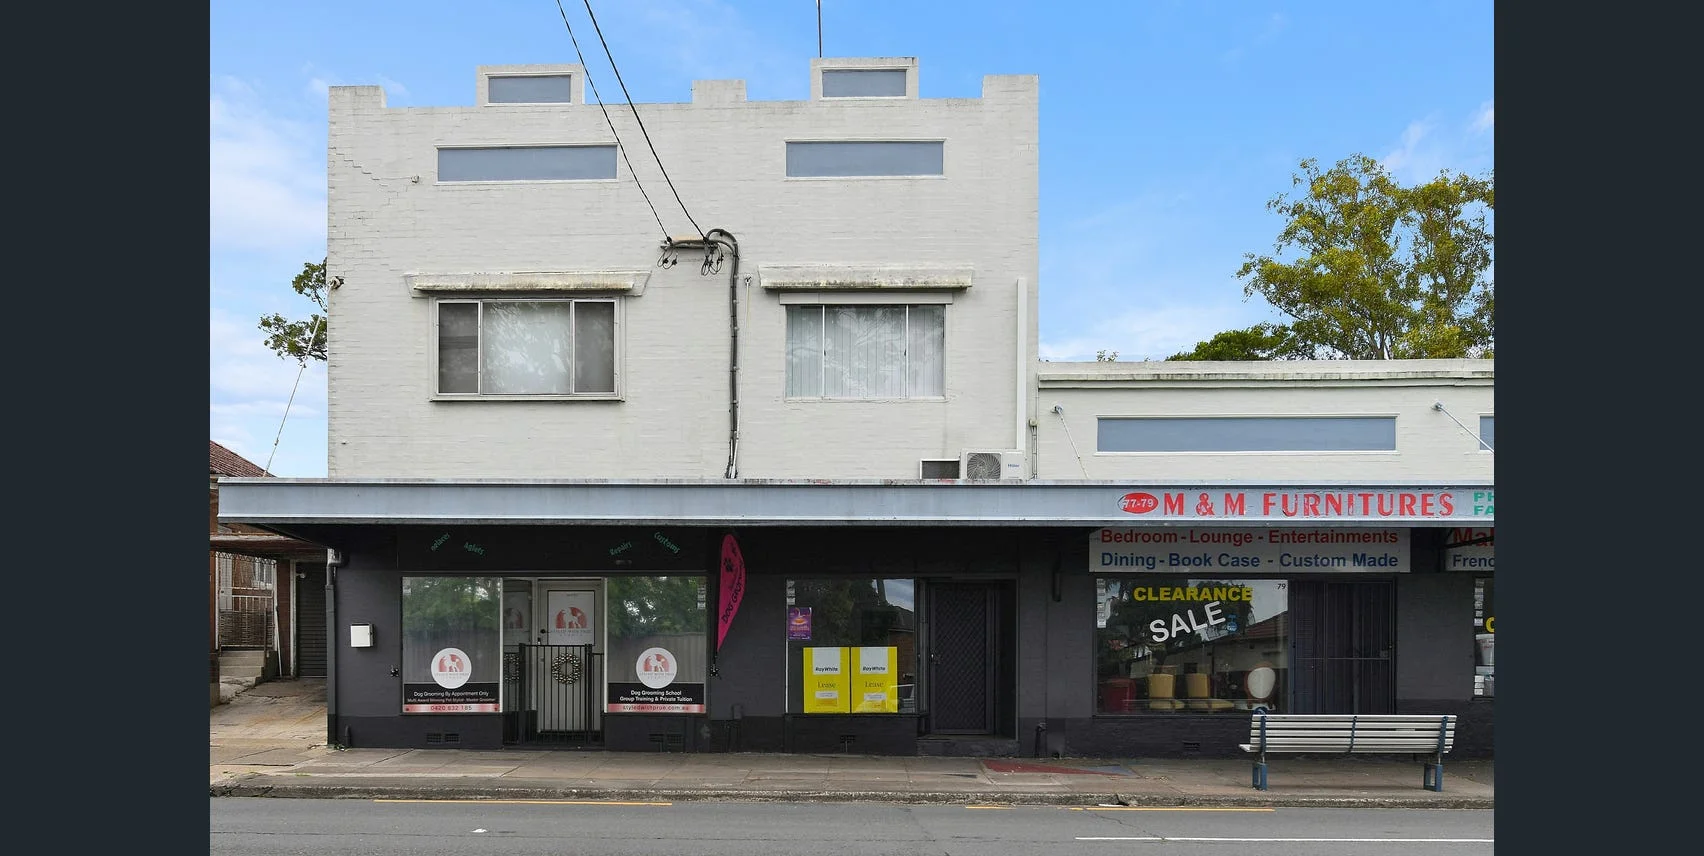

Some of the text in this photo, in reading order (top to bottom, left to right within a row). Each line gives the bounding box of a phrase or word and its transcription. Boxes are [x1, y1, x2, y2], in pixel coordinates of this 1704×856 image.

[1163, 492, 1454, 517] M & M FURNITURES
[653, 531, 680, 554] Customs
[1101, 529, 1178, 544] Bedroom
[1190, 529, 1253, 546] Lounge
[1269, 529, 1399, 544] Entertainments
[1101, 552, 1156, 569] Dining
[1168, 552, 1212, 567] Book
[1218, 552, 1260, 567] Case
[1279, 552, 1346, 567] Custom
[1352, 552, 1398, 567] Made
[1133, 586, 1254, 602] CLEARANCE
[1149, 600, 1226, 643] SALE
